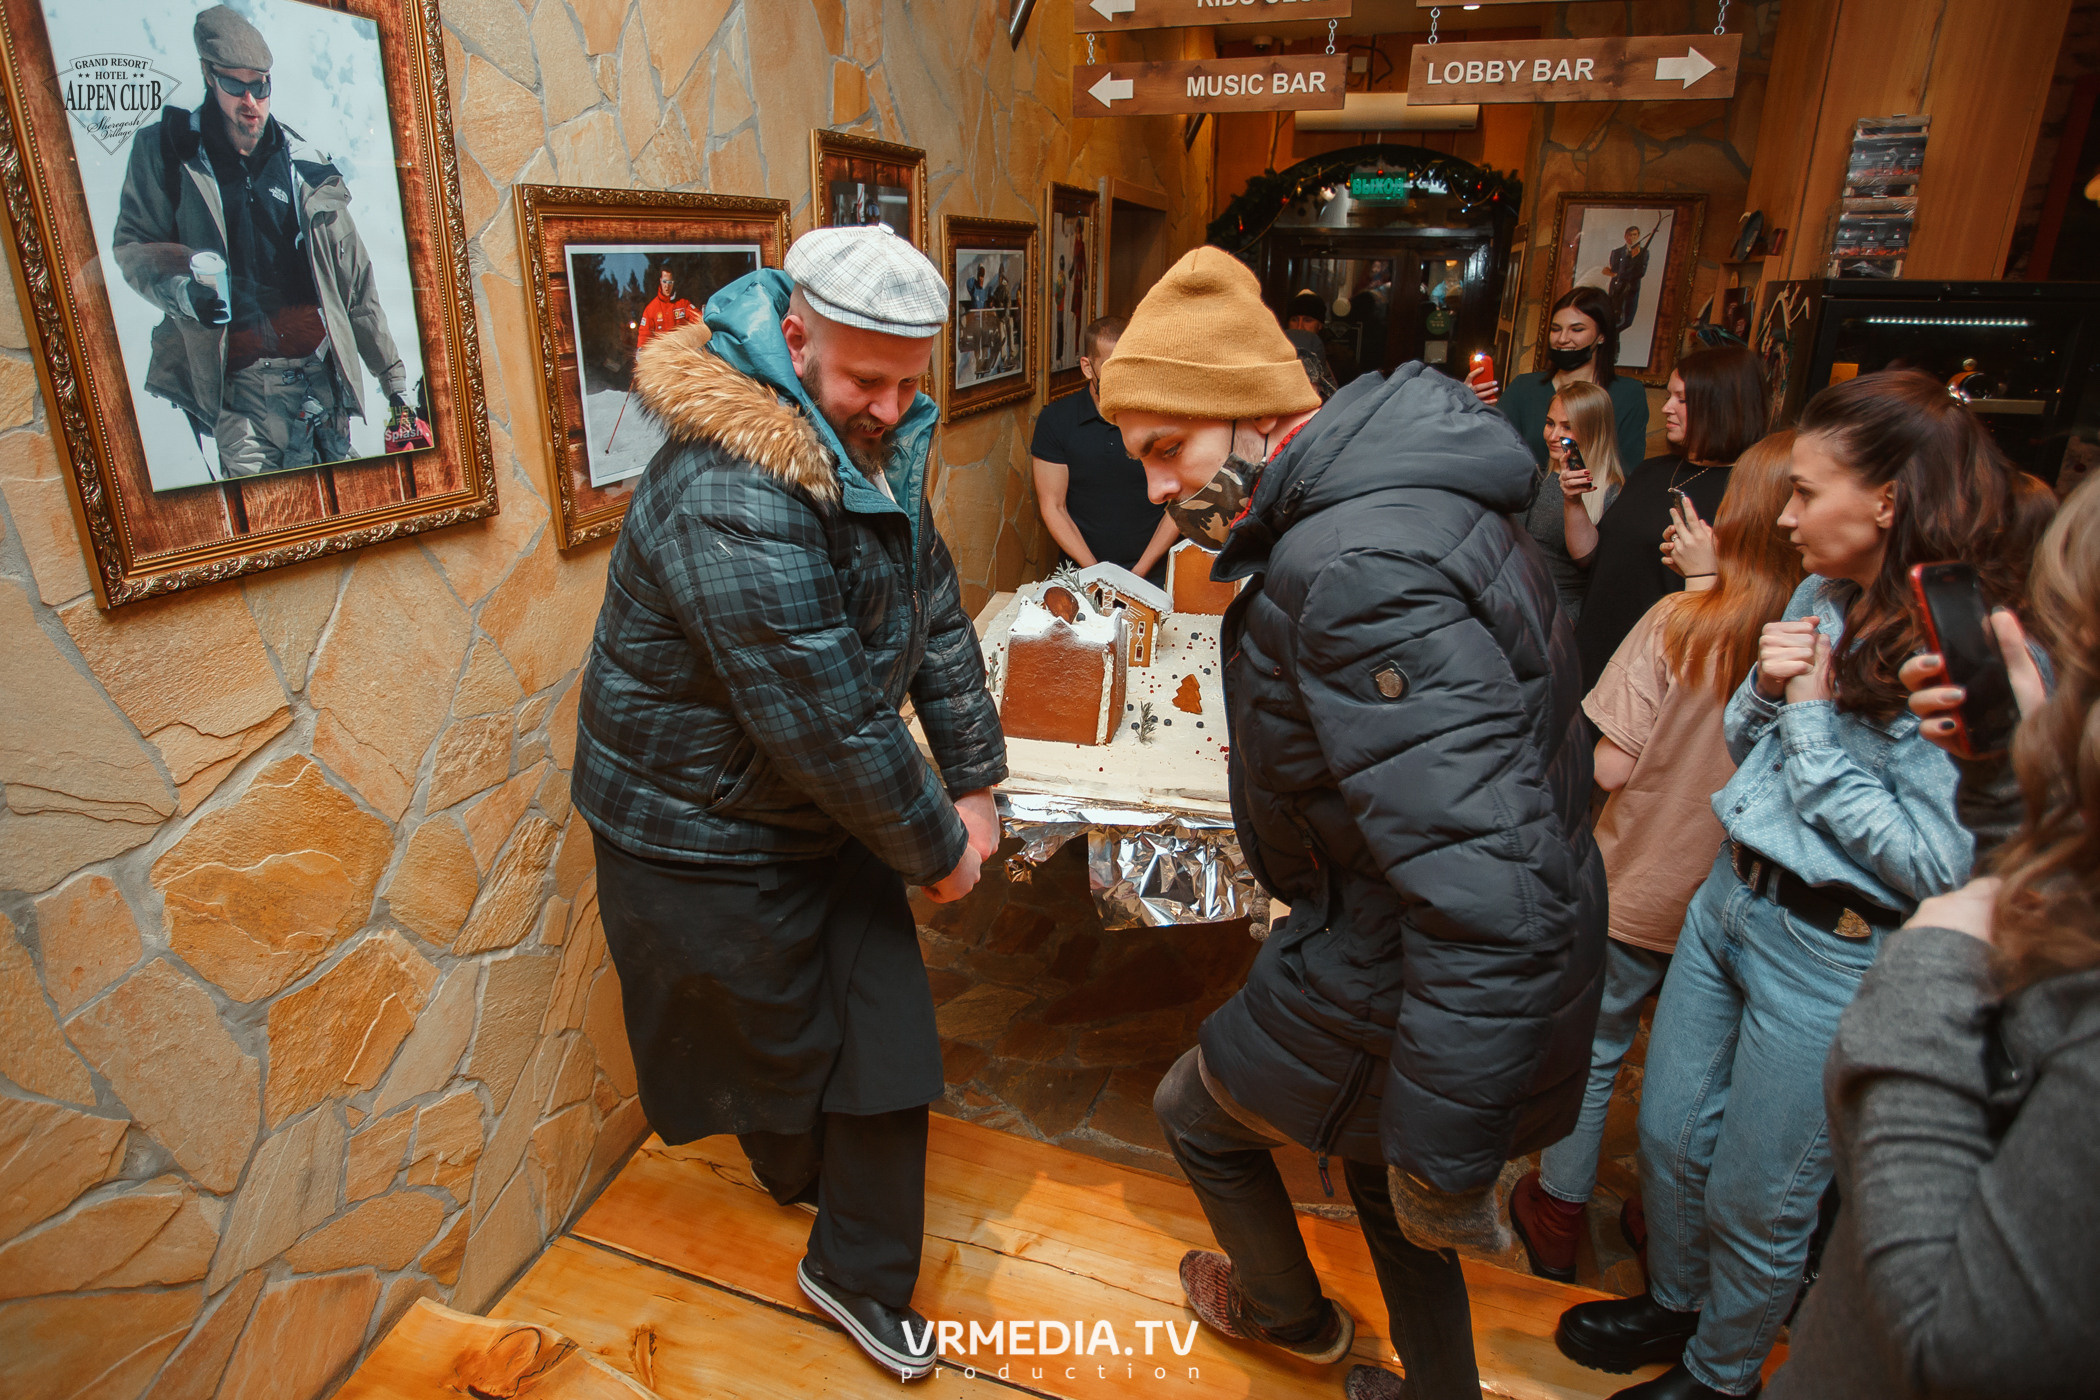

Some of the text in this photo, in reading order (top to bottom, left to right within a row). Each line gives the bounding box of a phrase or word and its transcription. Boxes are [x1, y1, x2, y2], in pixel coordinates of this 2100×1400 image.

[74, 58, 148, 70] GRAND RESORT
[1427, 58, 1594, 84] LOBBY BAR
[95, 71, 128, 80] HOTEL
[1186, 71, 1326, 97] MUSIC BAR
[64, 80, 162, 111] ALPEN CLUB
[86, 111, 144, 135] Sheregesh
[100, 128, 132, 143] Village
[1352, 178, 1404, 197] ВЫХОД
